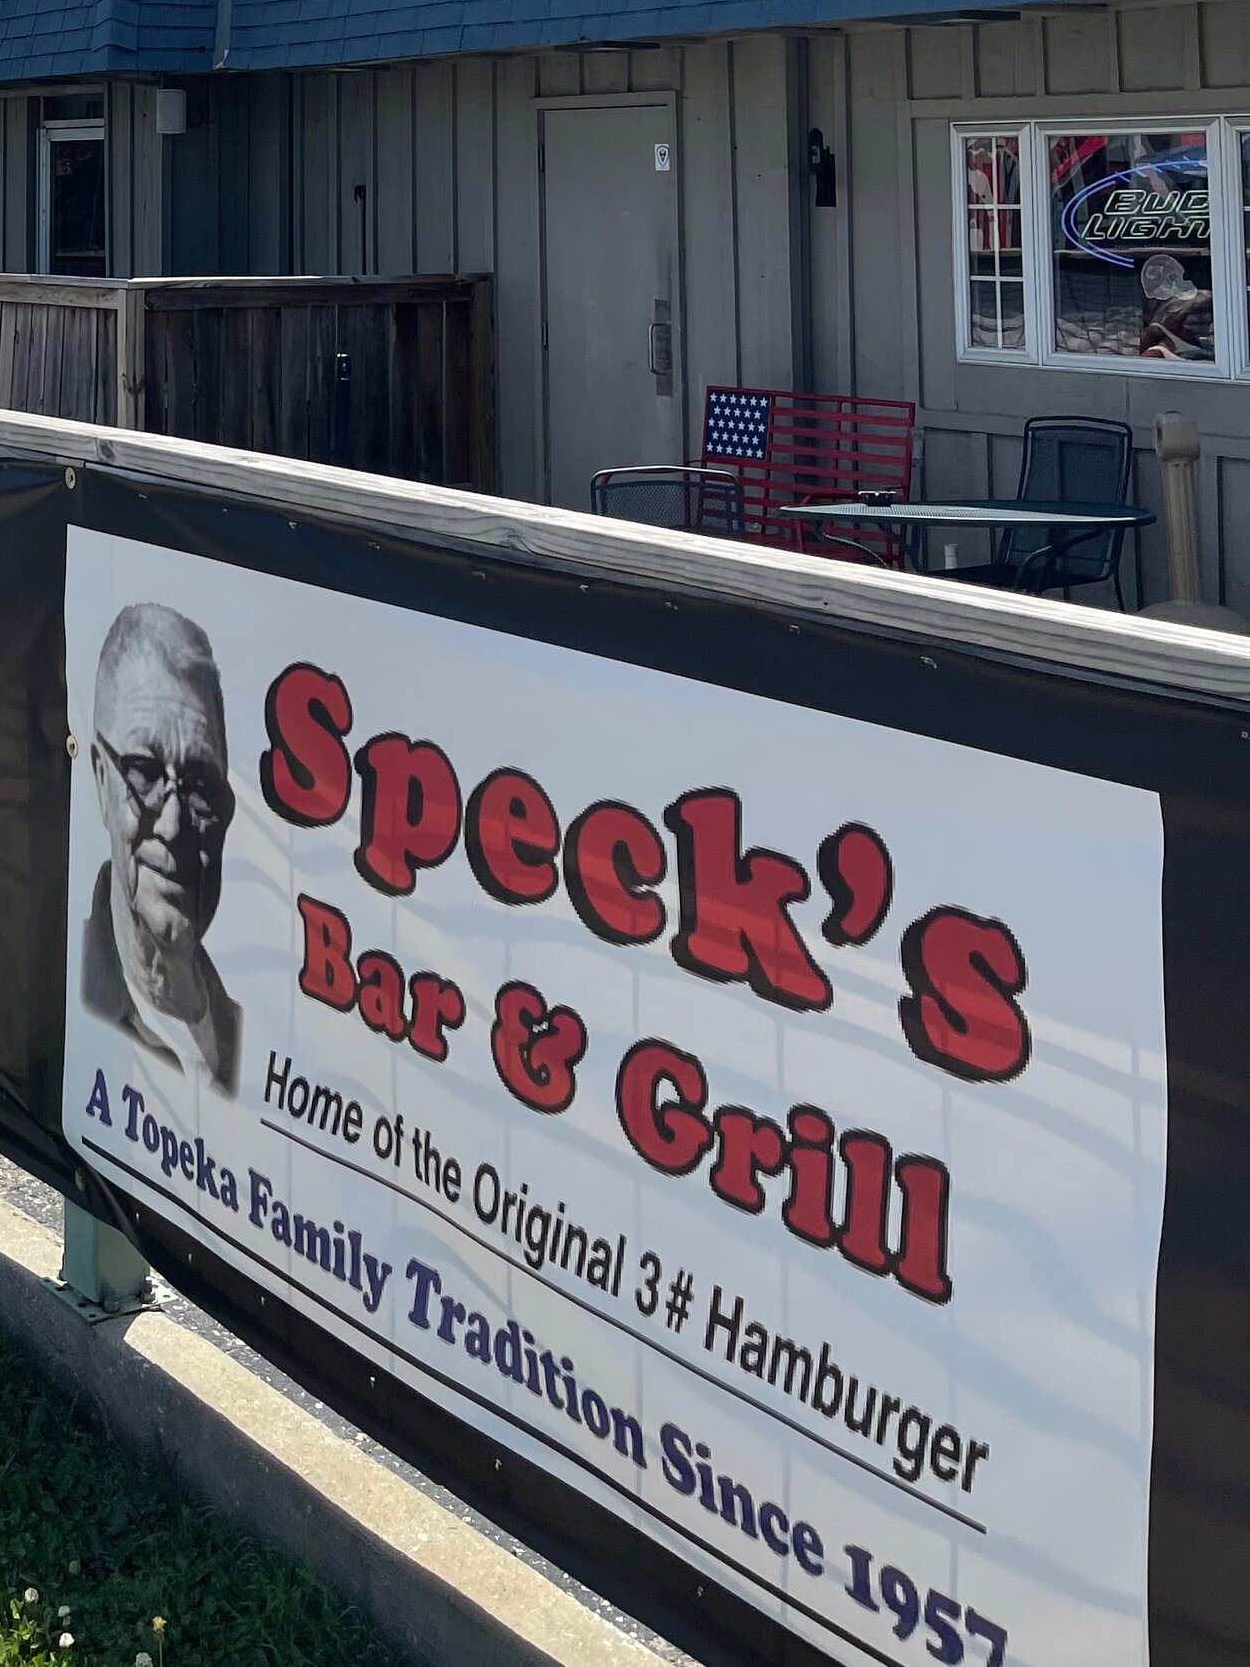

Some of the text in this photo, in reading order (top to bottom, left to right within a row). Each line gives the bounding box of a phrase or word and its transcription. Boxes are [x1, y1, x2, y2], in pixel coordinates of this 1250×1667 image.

[1081, 213, 1210, 240] LIGHT
[1104, 189, 1209, 215] BUD
[259, 660, 1032, 1084] Speck's
[264, 1050, 363, 1144] Home
[373, 1113, 405, 1167] of
[411, 1128, 462, 1204] the
[473, 1162, 627, 1298] Original
[703, 1284, 989, 1493] Hamburger
[296, 892, 954, 1306] Bar & Grill
[85, 1068, 1008, 1667] A Topeka Family Tradition Since 1957
